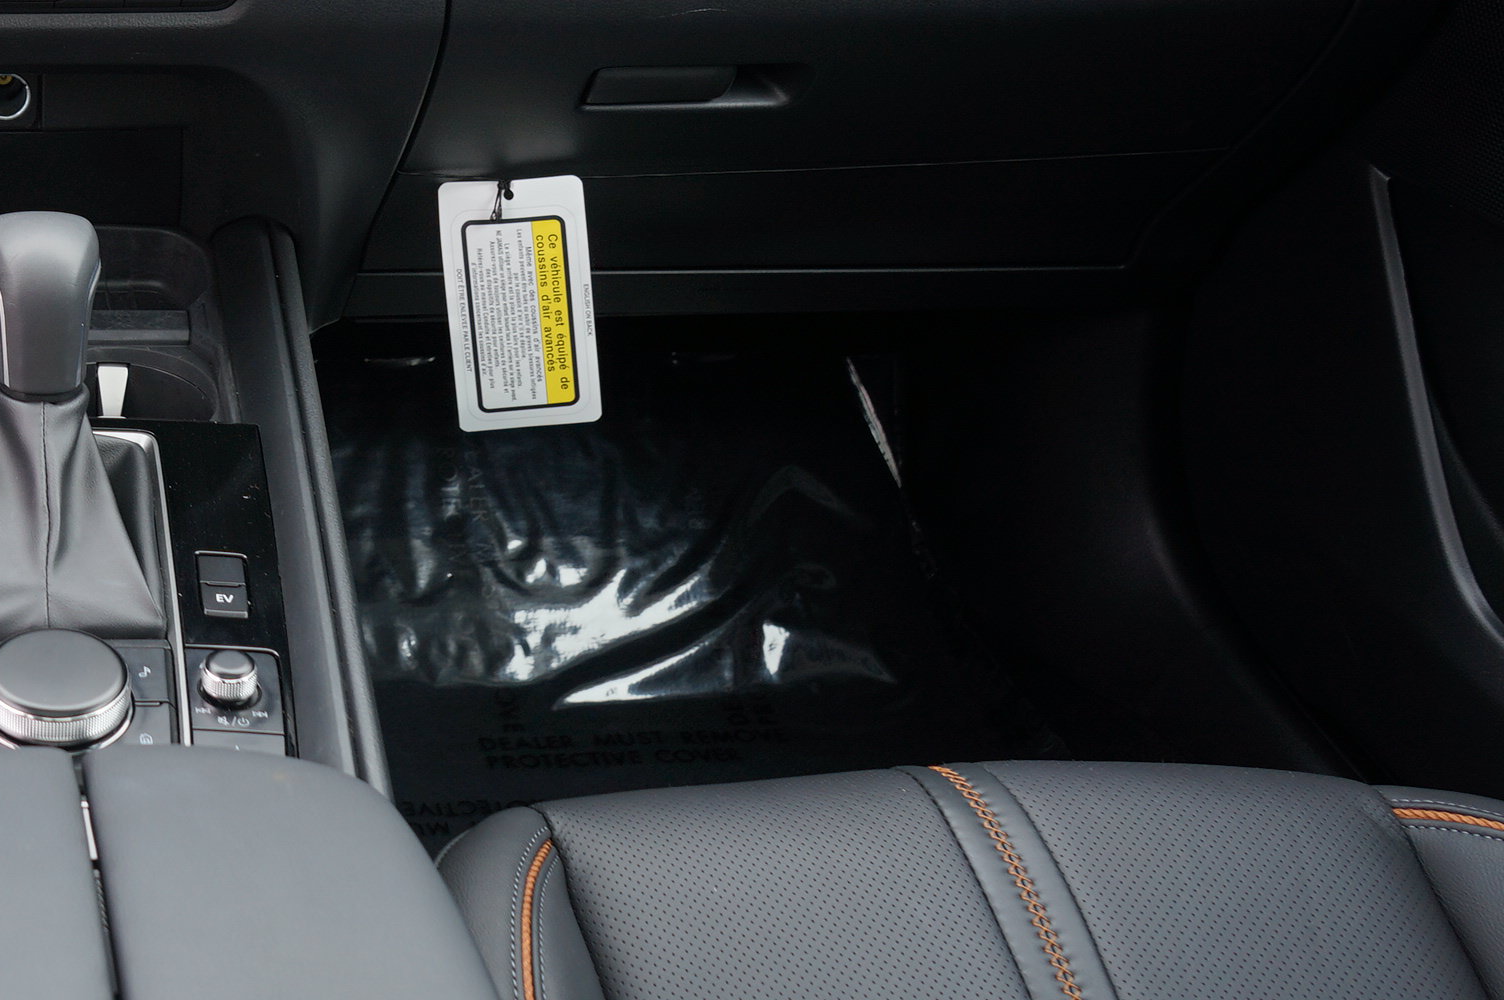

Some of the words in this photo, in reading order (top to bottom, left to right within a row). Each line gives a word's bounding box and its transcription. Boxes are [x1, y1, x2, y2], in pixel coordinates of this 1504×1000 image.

[548, 234, 559, 249] Ce
[536, 234, 549, 288] coussins
[456, 268, 464, 283] DOIT
[550, 256, 563, 303] véhicule
[458, 284, 467, 301] ÊTRE
[583, 284, 591, 309] ENGLISH
[525, 247, 533, 267] Même
[531, 305, 539, 334] coussins
[535, 356, 543, 382] avancés
[541, 294, 552, 320] d'air
[585, 310, 592, 320] ON
[554, 309, 564, 327] est
[462, 330, 470, 342] PAR
[544, 326, 557, 372] avancés
[554, 333, 569, 370] équipé
[465, 352, 473, 373] CLIENT
[560, 377, 570, 390] de
[216, 593, 234, 603] EV
